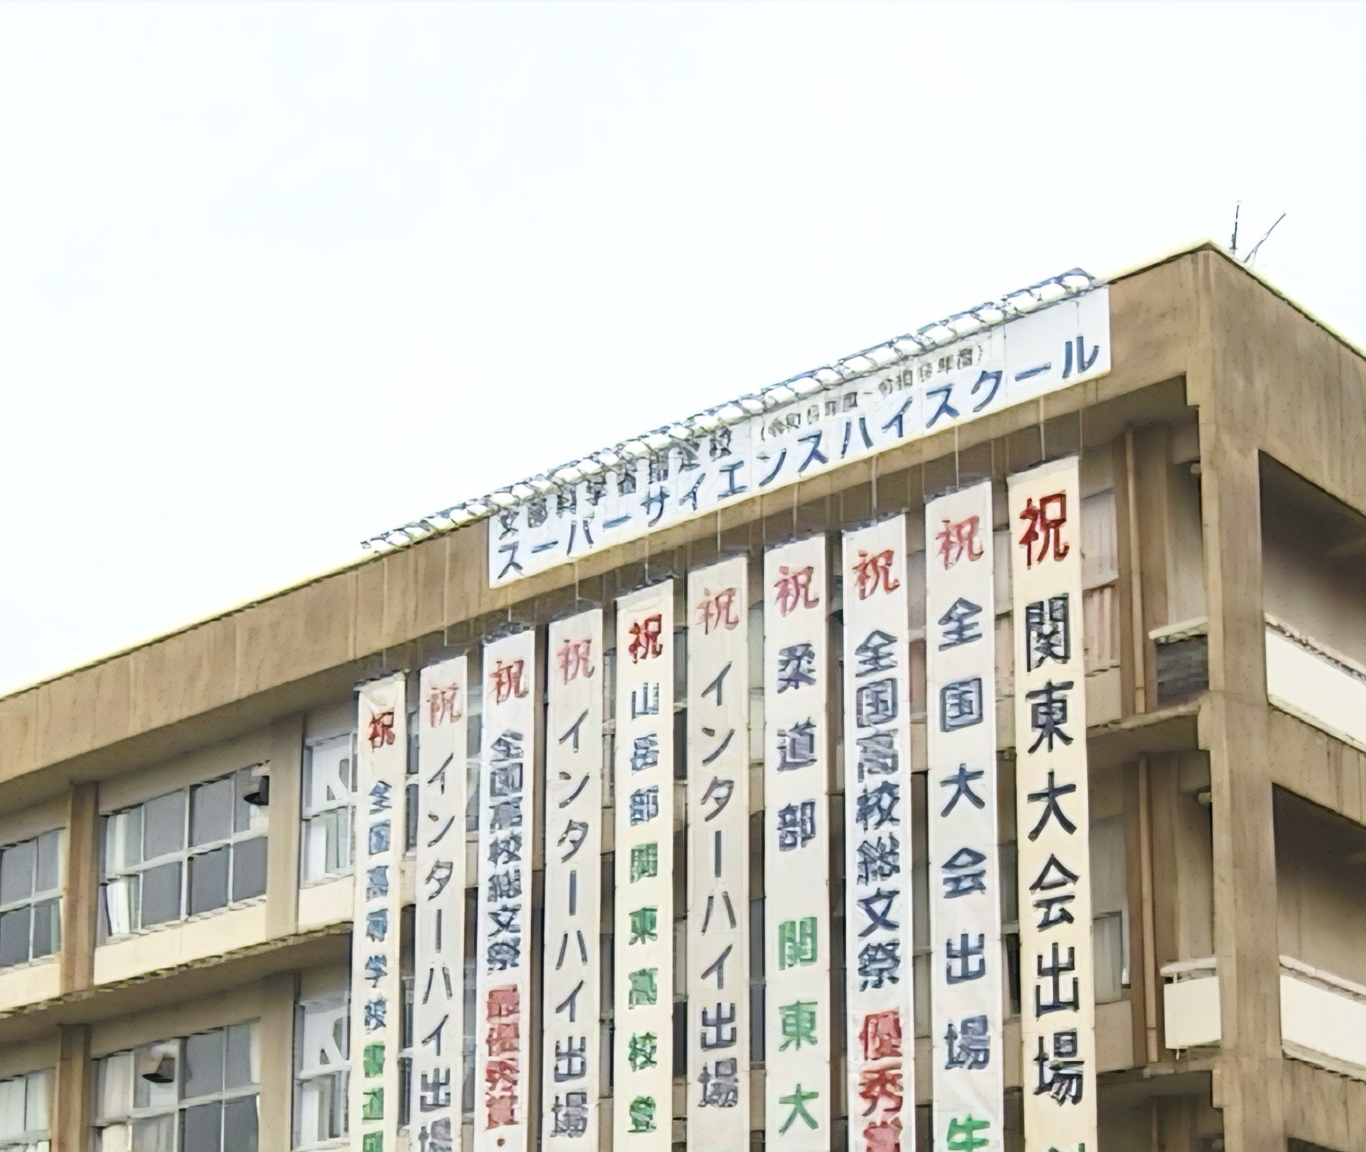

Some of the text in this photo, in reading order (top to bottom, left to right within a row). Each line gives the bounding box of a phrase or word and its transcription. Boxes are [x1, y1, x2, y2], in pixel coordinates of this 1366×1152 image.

[498, 334, 1100, 579] スーパーサイエンスハイスクール
[936, 515, 985, 571] 祝
[1018, 492, 1070, 571] 祝
[852, 549, 901, 600] 祝
[697, 587, 740, 635] 祝
[491, 659, 528, 703] 祝
[557, 637, 595, 685] 祝
[426, 682, 462, 728] 祝
[938, 597, 991, 1070] 全国大会出場
[1025, 593, 1084, 1107] 関東大会出場
[697, 660, 740, 1108] インターハイ出場
[550, 709, 589, 1138] インターハイ出場
